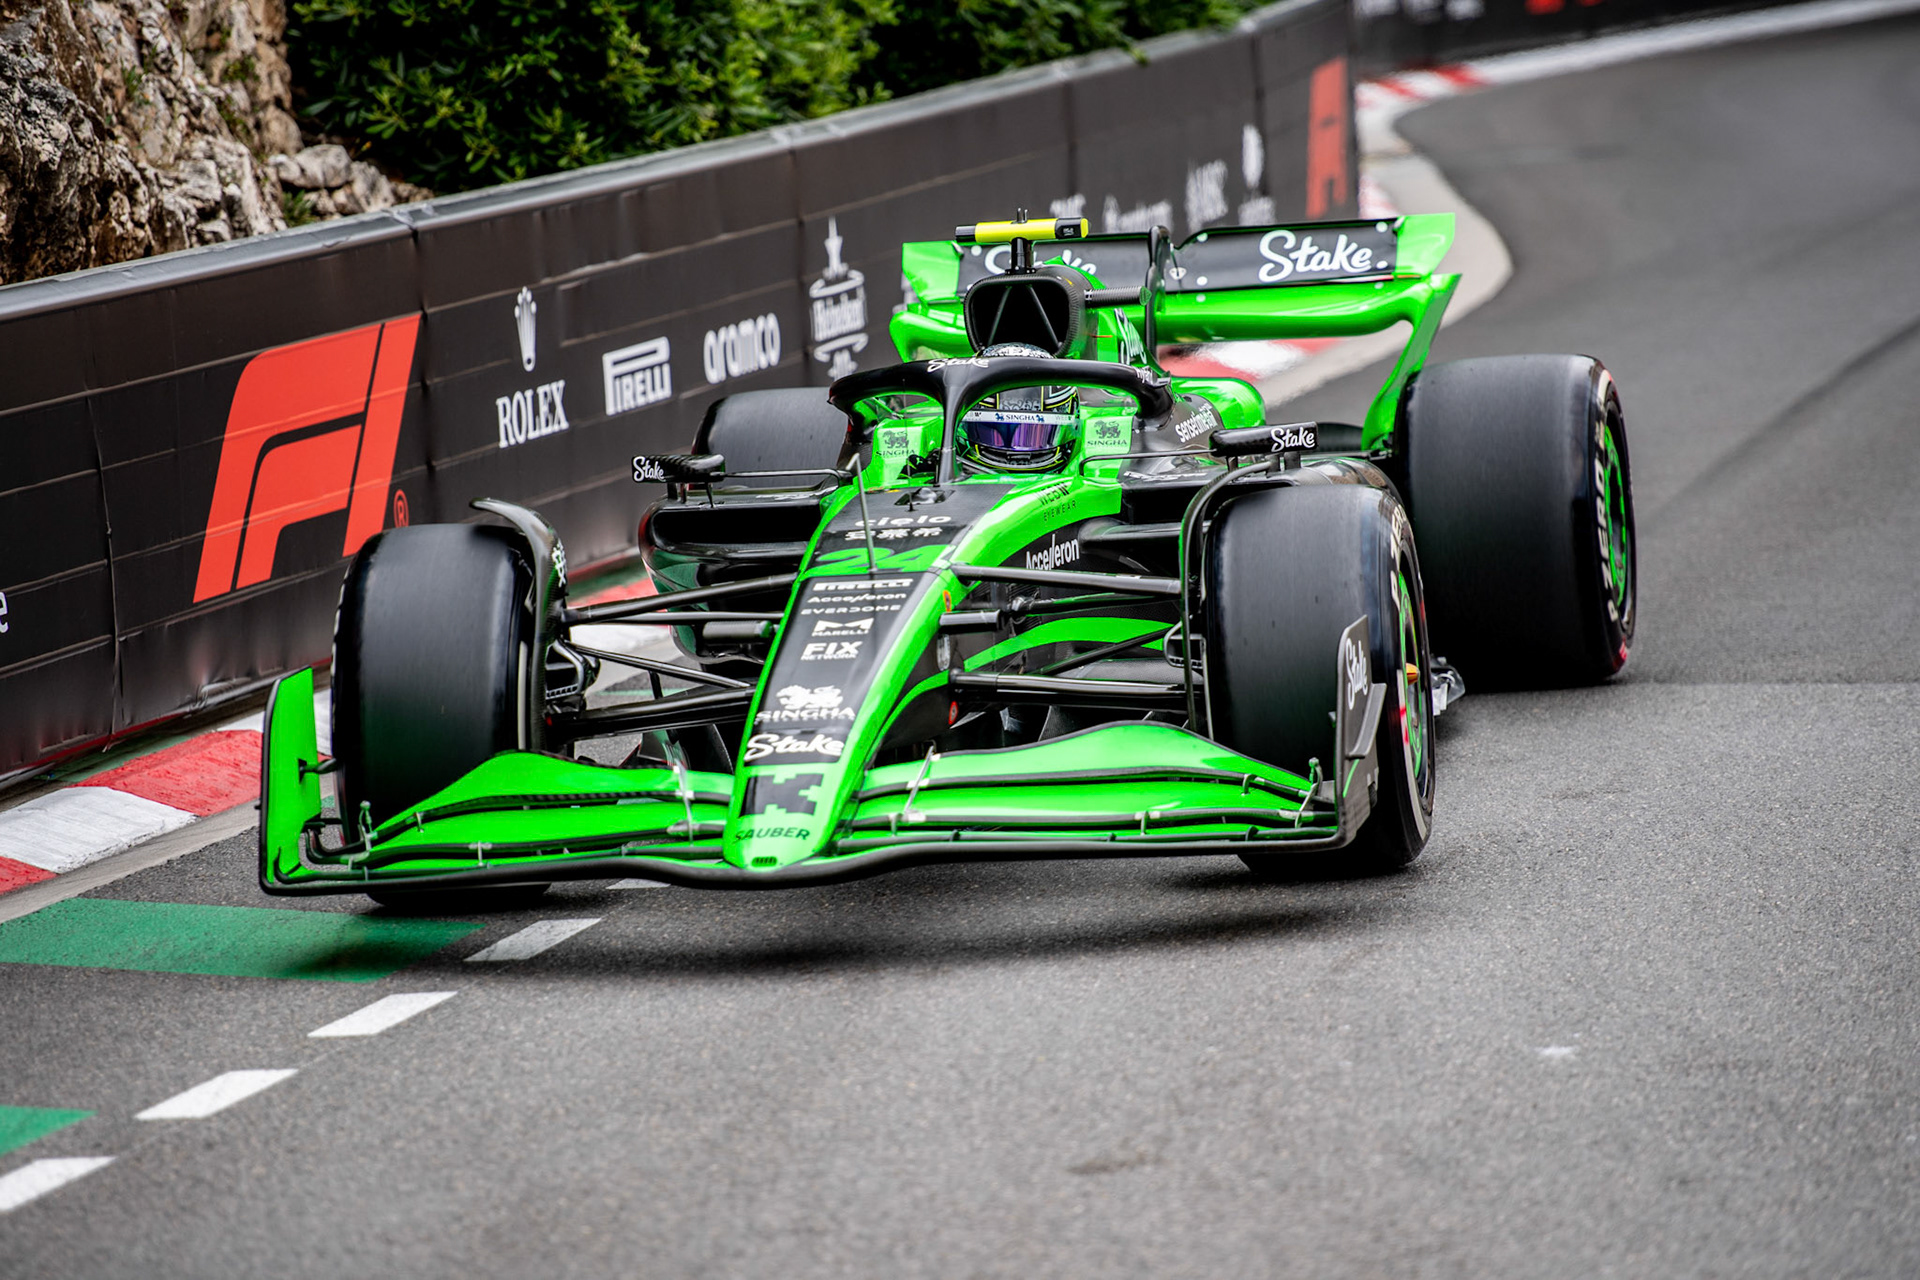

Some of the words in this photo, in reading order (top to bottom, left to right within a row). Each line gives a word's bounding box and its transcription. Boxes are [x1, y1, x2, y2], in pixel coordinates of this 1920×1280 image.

[1258, 229, 1373, 283] Stake
[704, 312, 782, 385] aramco
[927, 356, 990, 373] Stake
[602, 336, 672, 416] PIRELLI
[496, 379, 569, 448] ROLEX
[1087, 439, 1127, 448] SINGHA
[1271, 427, 1315, 452] Stake
[875, 449, 915, 457] SINGHA
[633, 456, 666, 482] Stake
[813, 578, 914, 591] PIRELLI
[801, 604, 901, 615] EVERDOME
[811, 629, 869, 637] MARELLI
[802, 641, 863, 655] FIX
[801, 653, 857, 661] NETWORK
[755, 708, 856, 722] SINGHA
[744, 734, 845, 761] Stake
[732, 827, 811, 844] SAUBER
